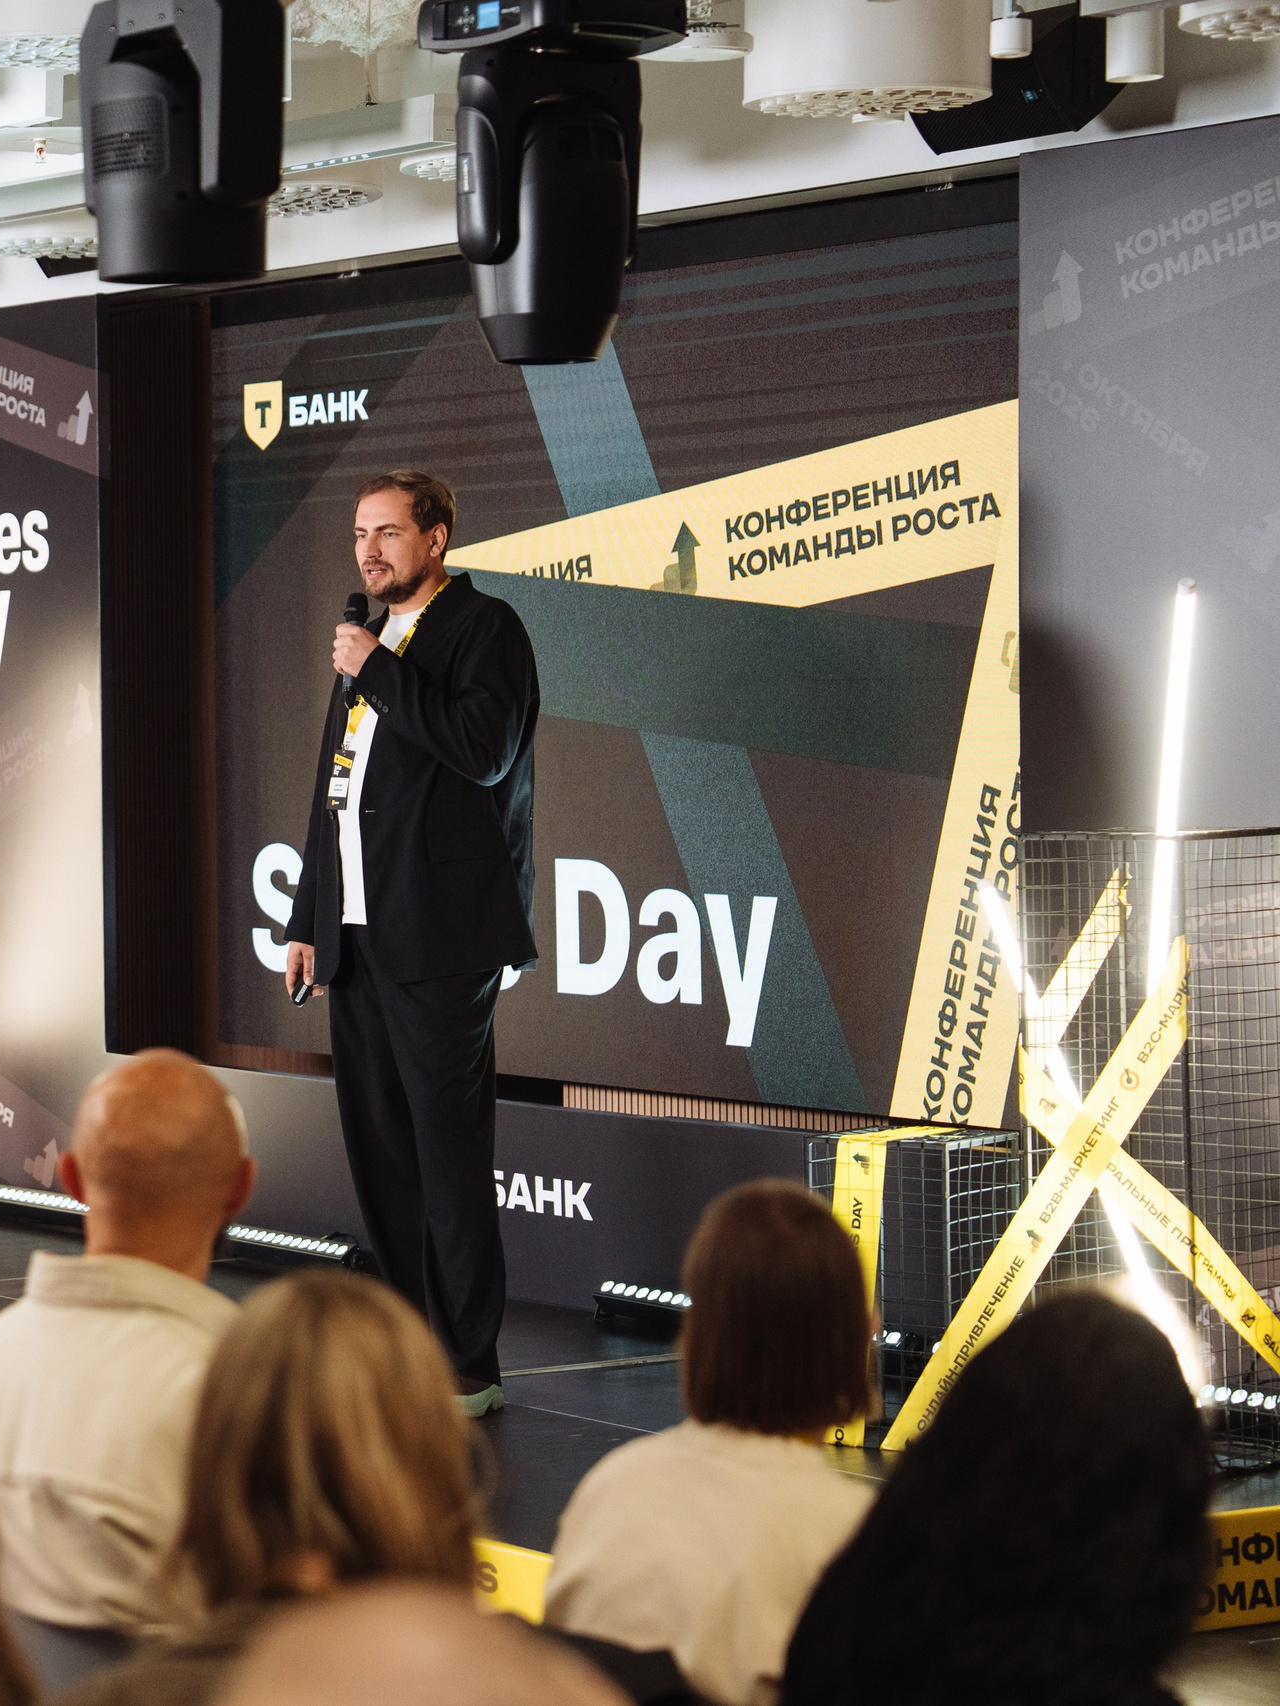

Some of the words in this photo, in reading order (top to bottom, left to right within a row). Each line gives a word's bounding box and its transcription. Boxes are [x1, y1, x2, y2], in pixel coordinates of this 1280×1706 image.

[1115, 175, 1280, 265] КОНФЕРЕ
[289, 389, 370, 428] БАНК
[1078, 363, 1211, 477] ОКТЯБРЯ
[724, 459, 962, 544] КОНФЕРЕНЦИЯ
[728, 519, 884, 582] КОМАНДЫ
[892, 492, 1002, 544] РОСТА
[3, 740, 55, 786] РОСТА
[993, 757, 1021, 903] РОСТ
[554, 858, 779, 1049] Day
[851, 1196, 863, 1230] DAY
[1105, 1161, 1172, 1229] РАЛЬНЫЕ
[1170, 1225, 1238, 1302] ПРОГРАММЫ
[916, 1255, 1025, 1435] ОНЛАЙН-ПРИВЛЕЧЕНИЕ
